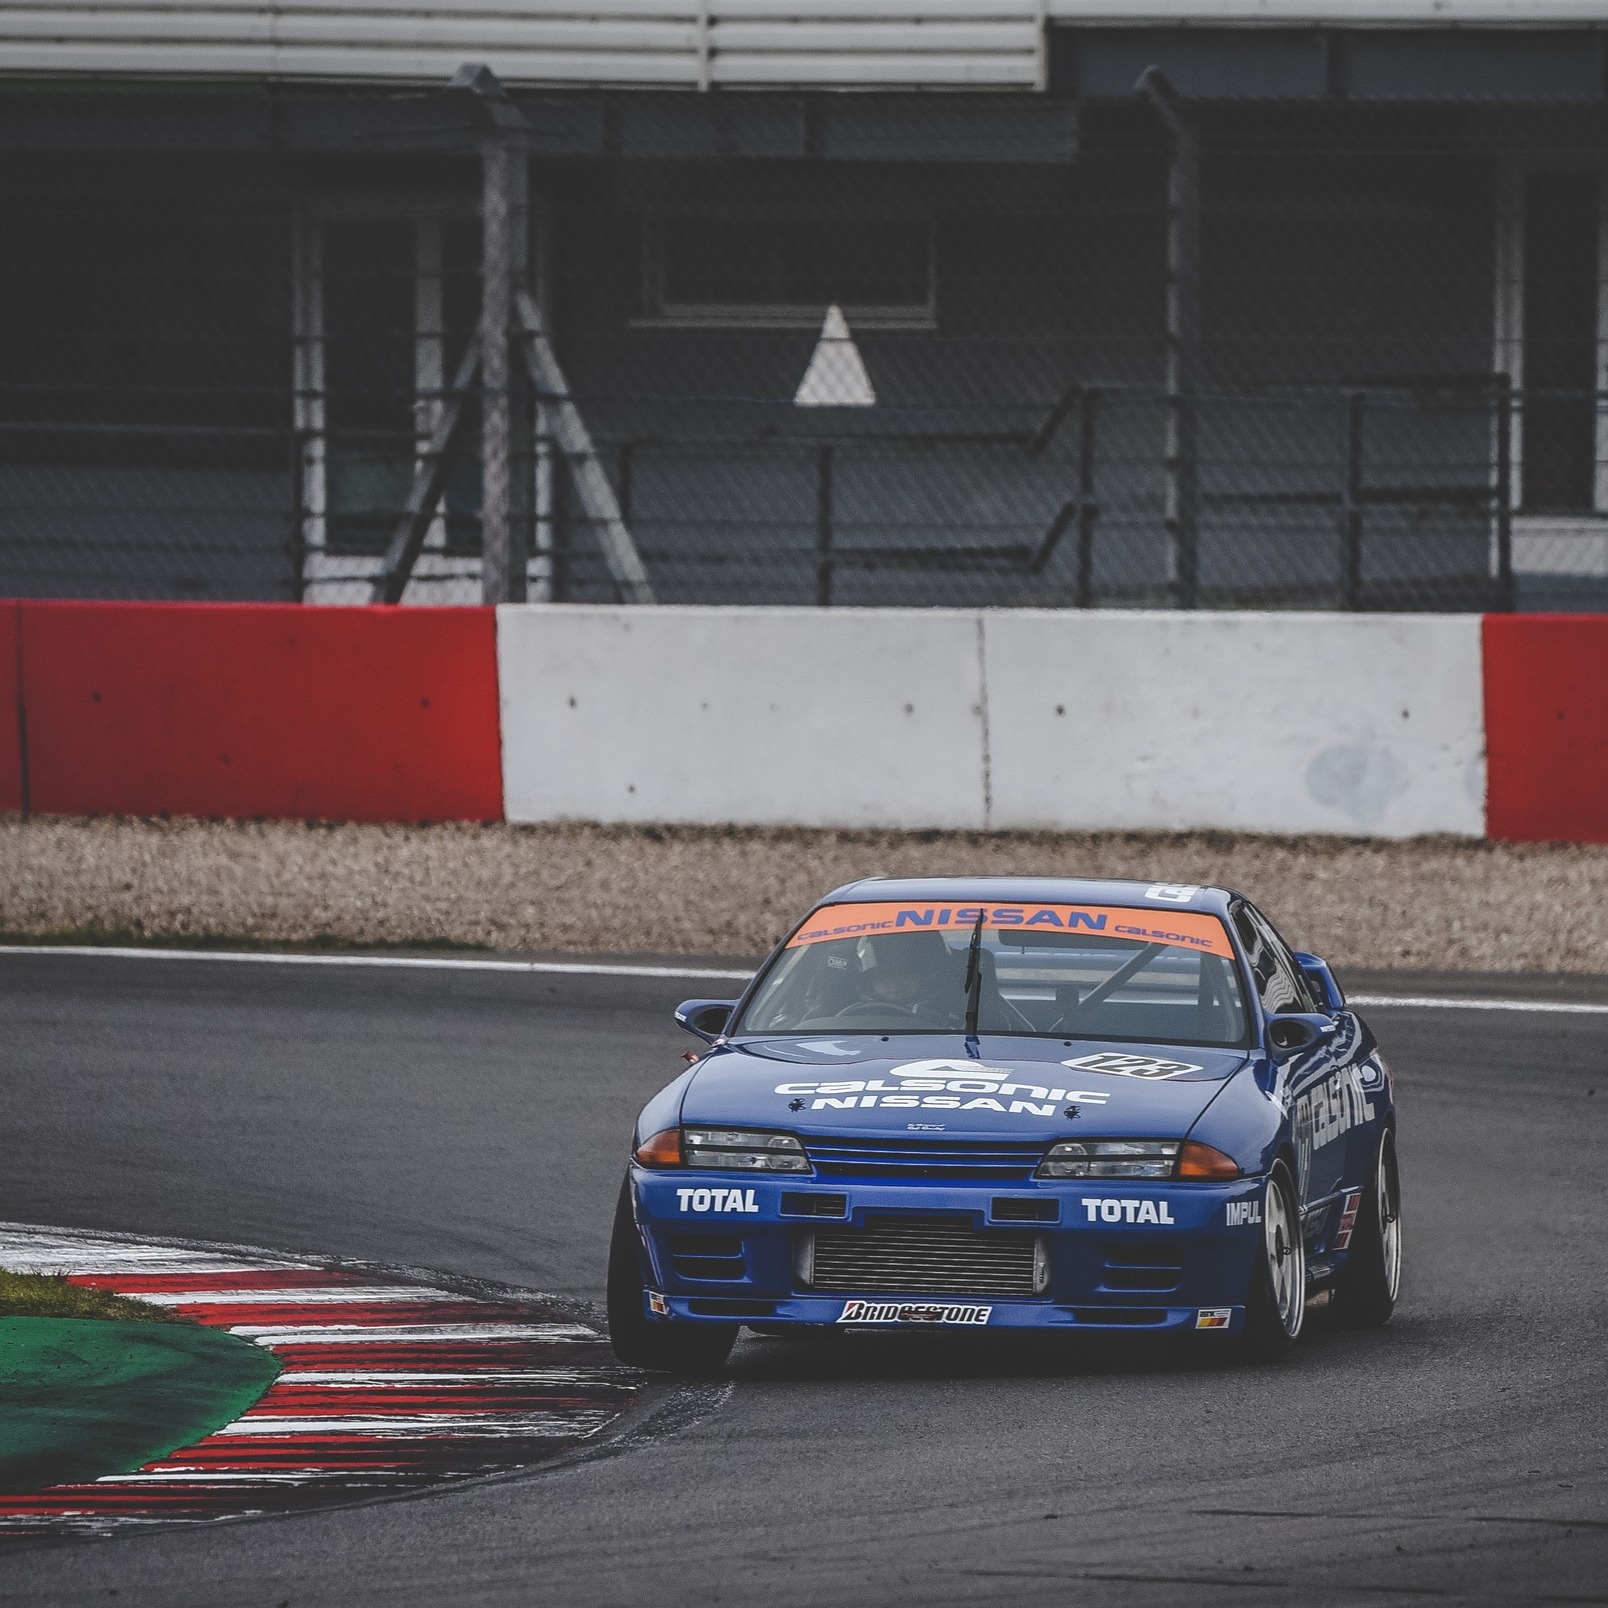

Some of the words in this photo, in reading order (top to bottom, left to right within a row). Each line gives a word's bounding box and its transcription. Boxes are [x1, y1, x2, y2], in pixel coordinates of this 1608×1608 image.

[895, 908, 1108, 931] NISSAN
[1074, 1055, 1191, 1078] 123
[810, 1095, 1057, 1117] NISSAN
[676, 1188, 759, 1213] TOTAL
[1081, 1198, 1175, 1225] TOTAL
[1226, 1201, 1262, 1226] IMPUL
[840, 1301, 990, 1323] BRIDGESTONE
